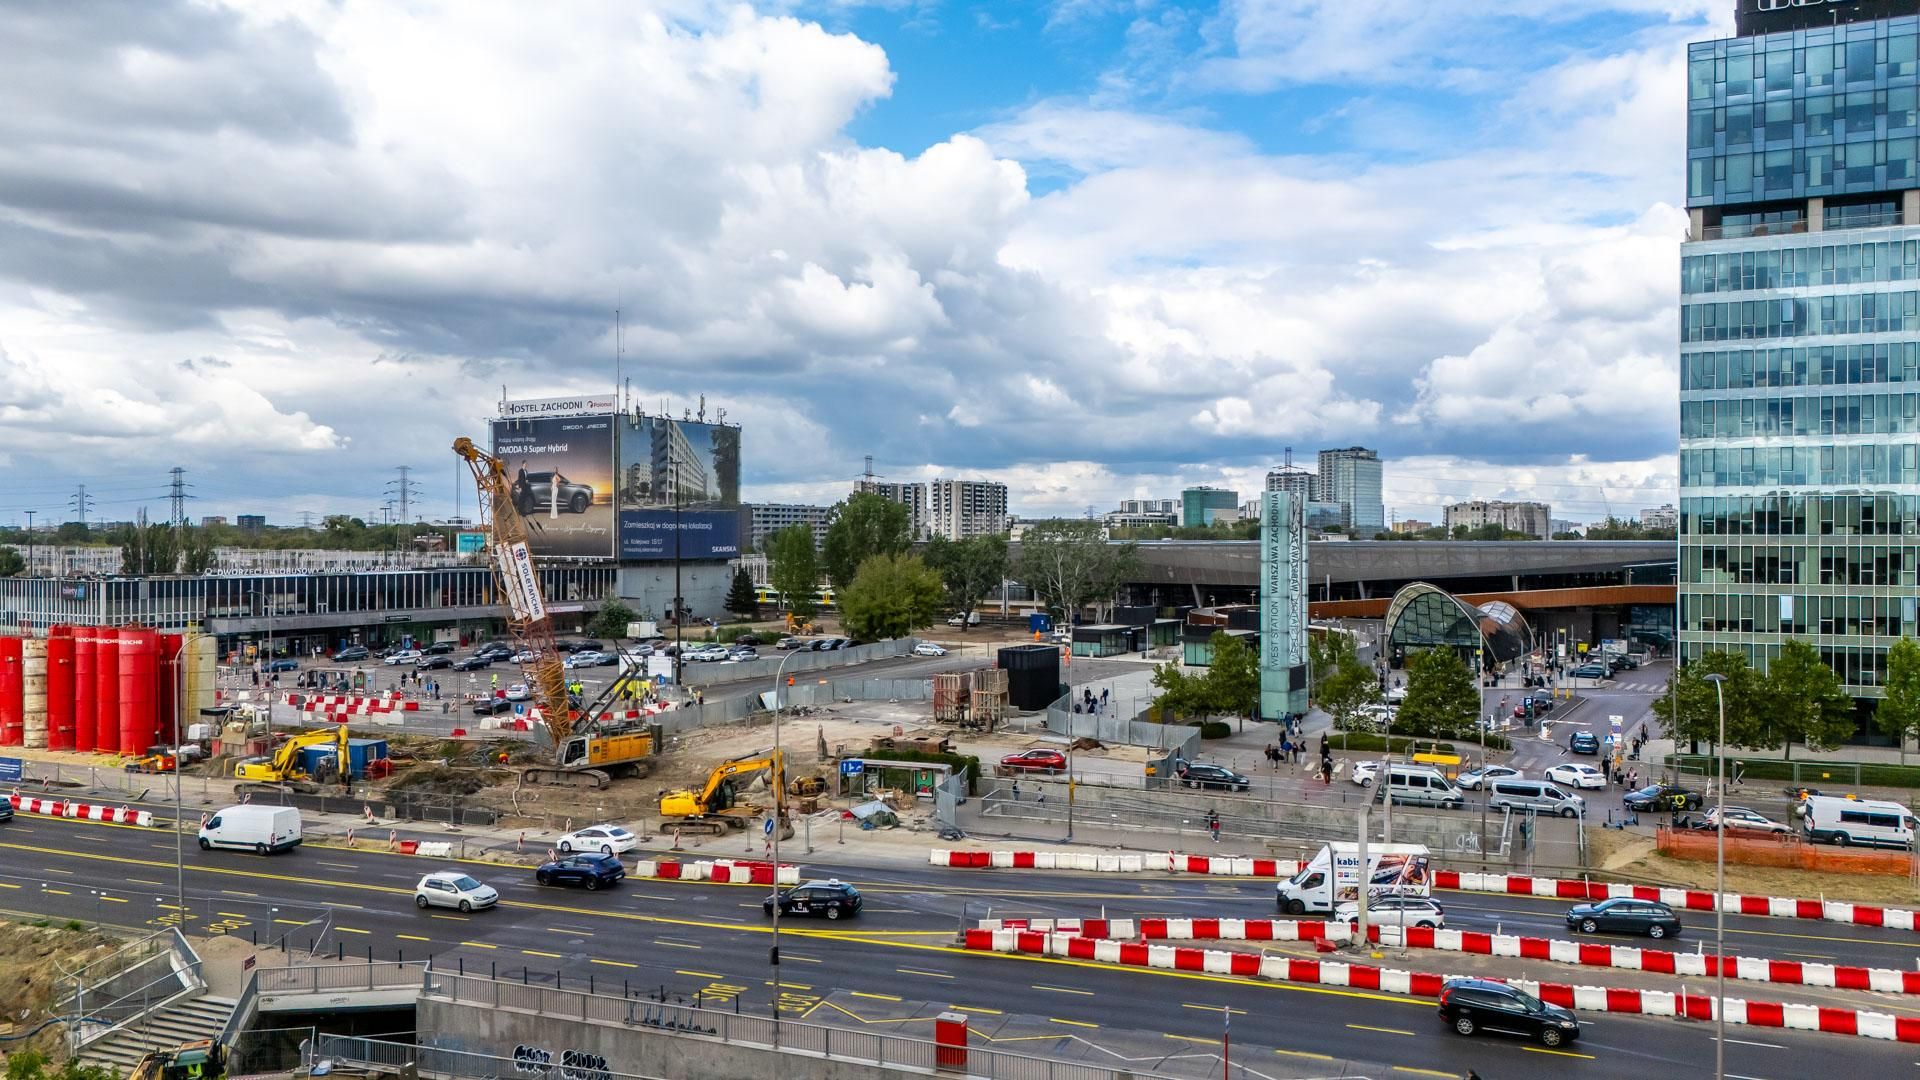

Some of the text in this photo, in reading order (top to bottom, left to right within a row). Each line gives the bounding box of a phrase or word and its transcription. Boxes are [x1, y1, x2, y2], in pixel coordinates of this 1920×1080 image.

[509, 401, 583, 414] HOSTEL ZACHODNI
[498, 446, 523, 454] OMODA
[529, 445, 546, 454] Super
[547, 443, 568, 454] Hybrid
[623, 520, 656, 530] Zamieszkaj
[711, 545, 737, 553] SKANSKA
[217, 564, 412, 576] DWORZEC AUTOBUSOWY WARSZAWA ZACHODNIA
[1271, 493, 1279, 667] WEST STATION WARSZAWA ZACHODNIA
